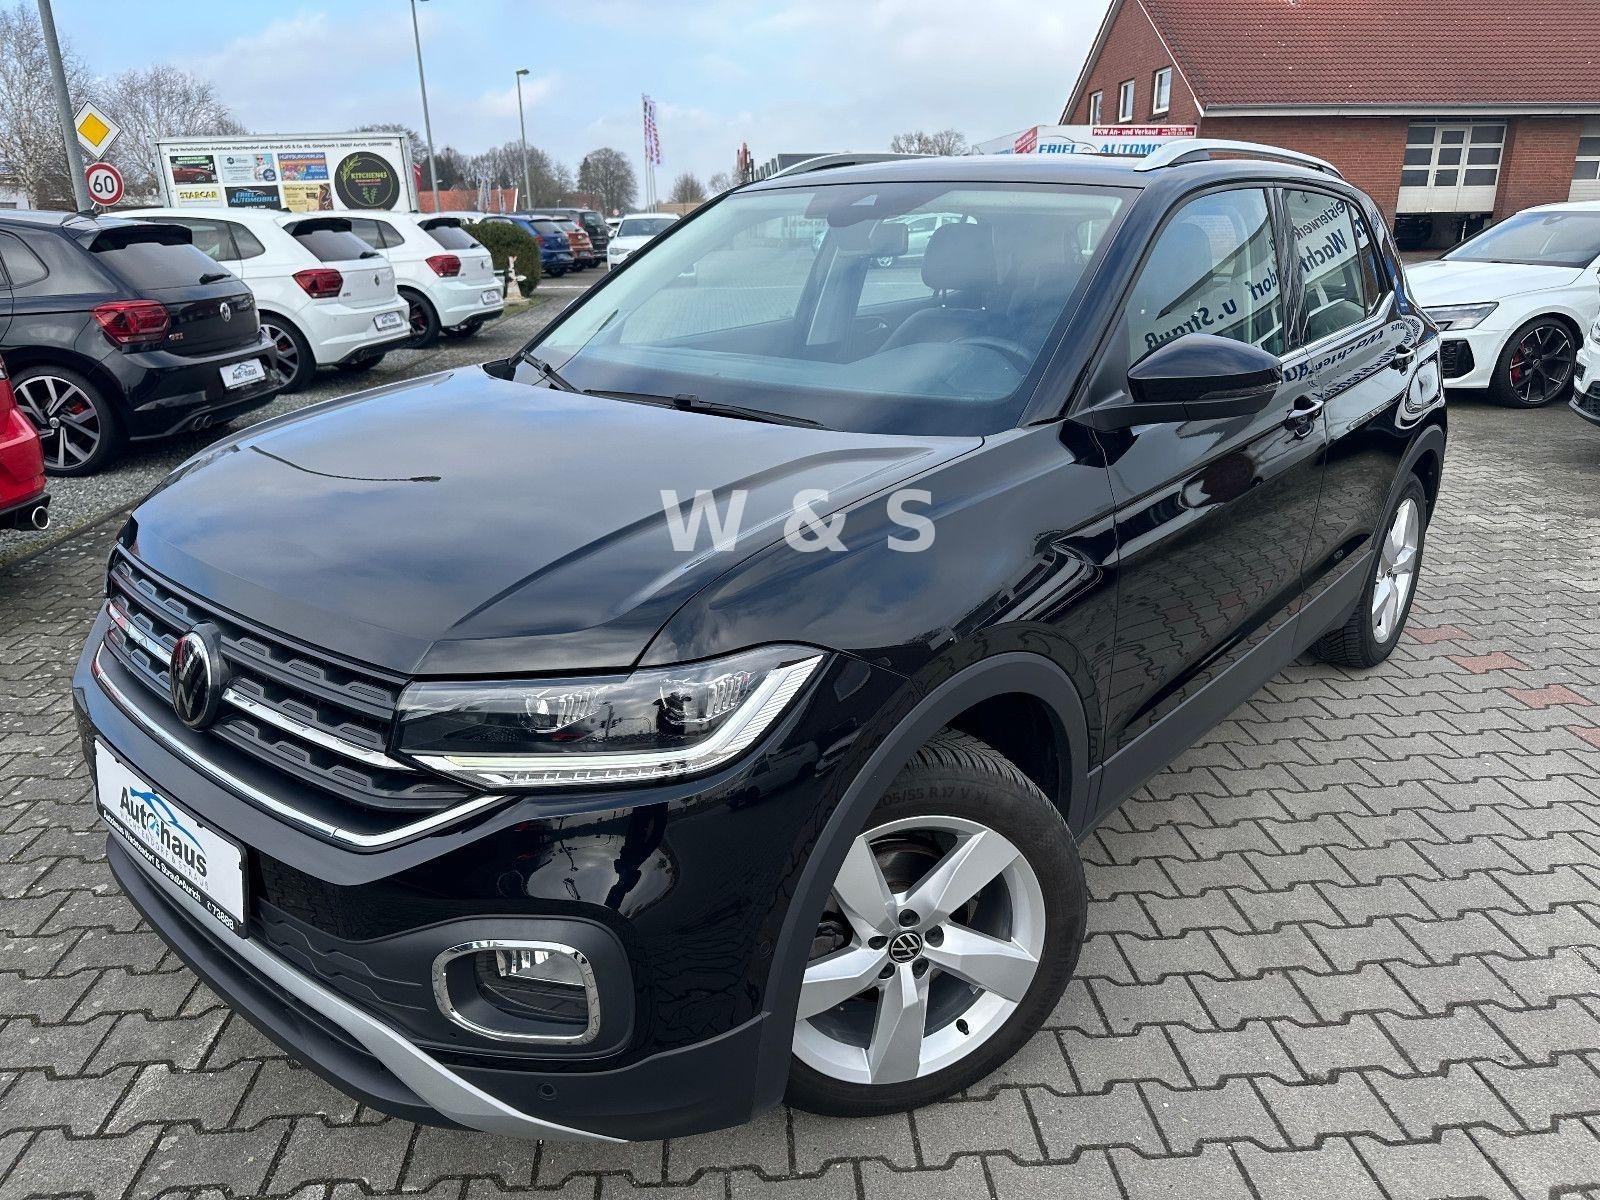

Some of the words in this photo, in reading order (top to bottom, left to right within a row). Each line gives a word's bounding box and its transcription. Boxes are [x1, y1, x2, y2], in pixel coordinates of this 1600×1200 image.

[1101, 143, 1163, 154] AUTOMO
[93, 175, 115, 194] 60
[179, 190, 217, 199] STARCAR
[881, 787, 924, 806] 05/55
[119, 786, 208, 878] Autohaus
